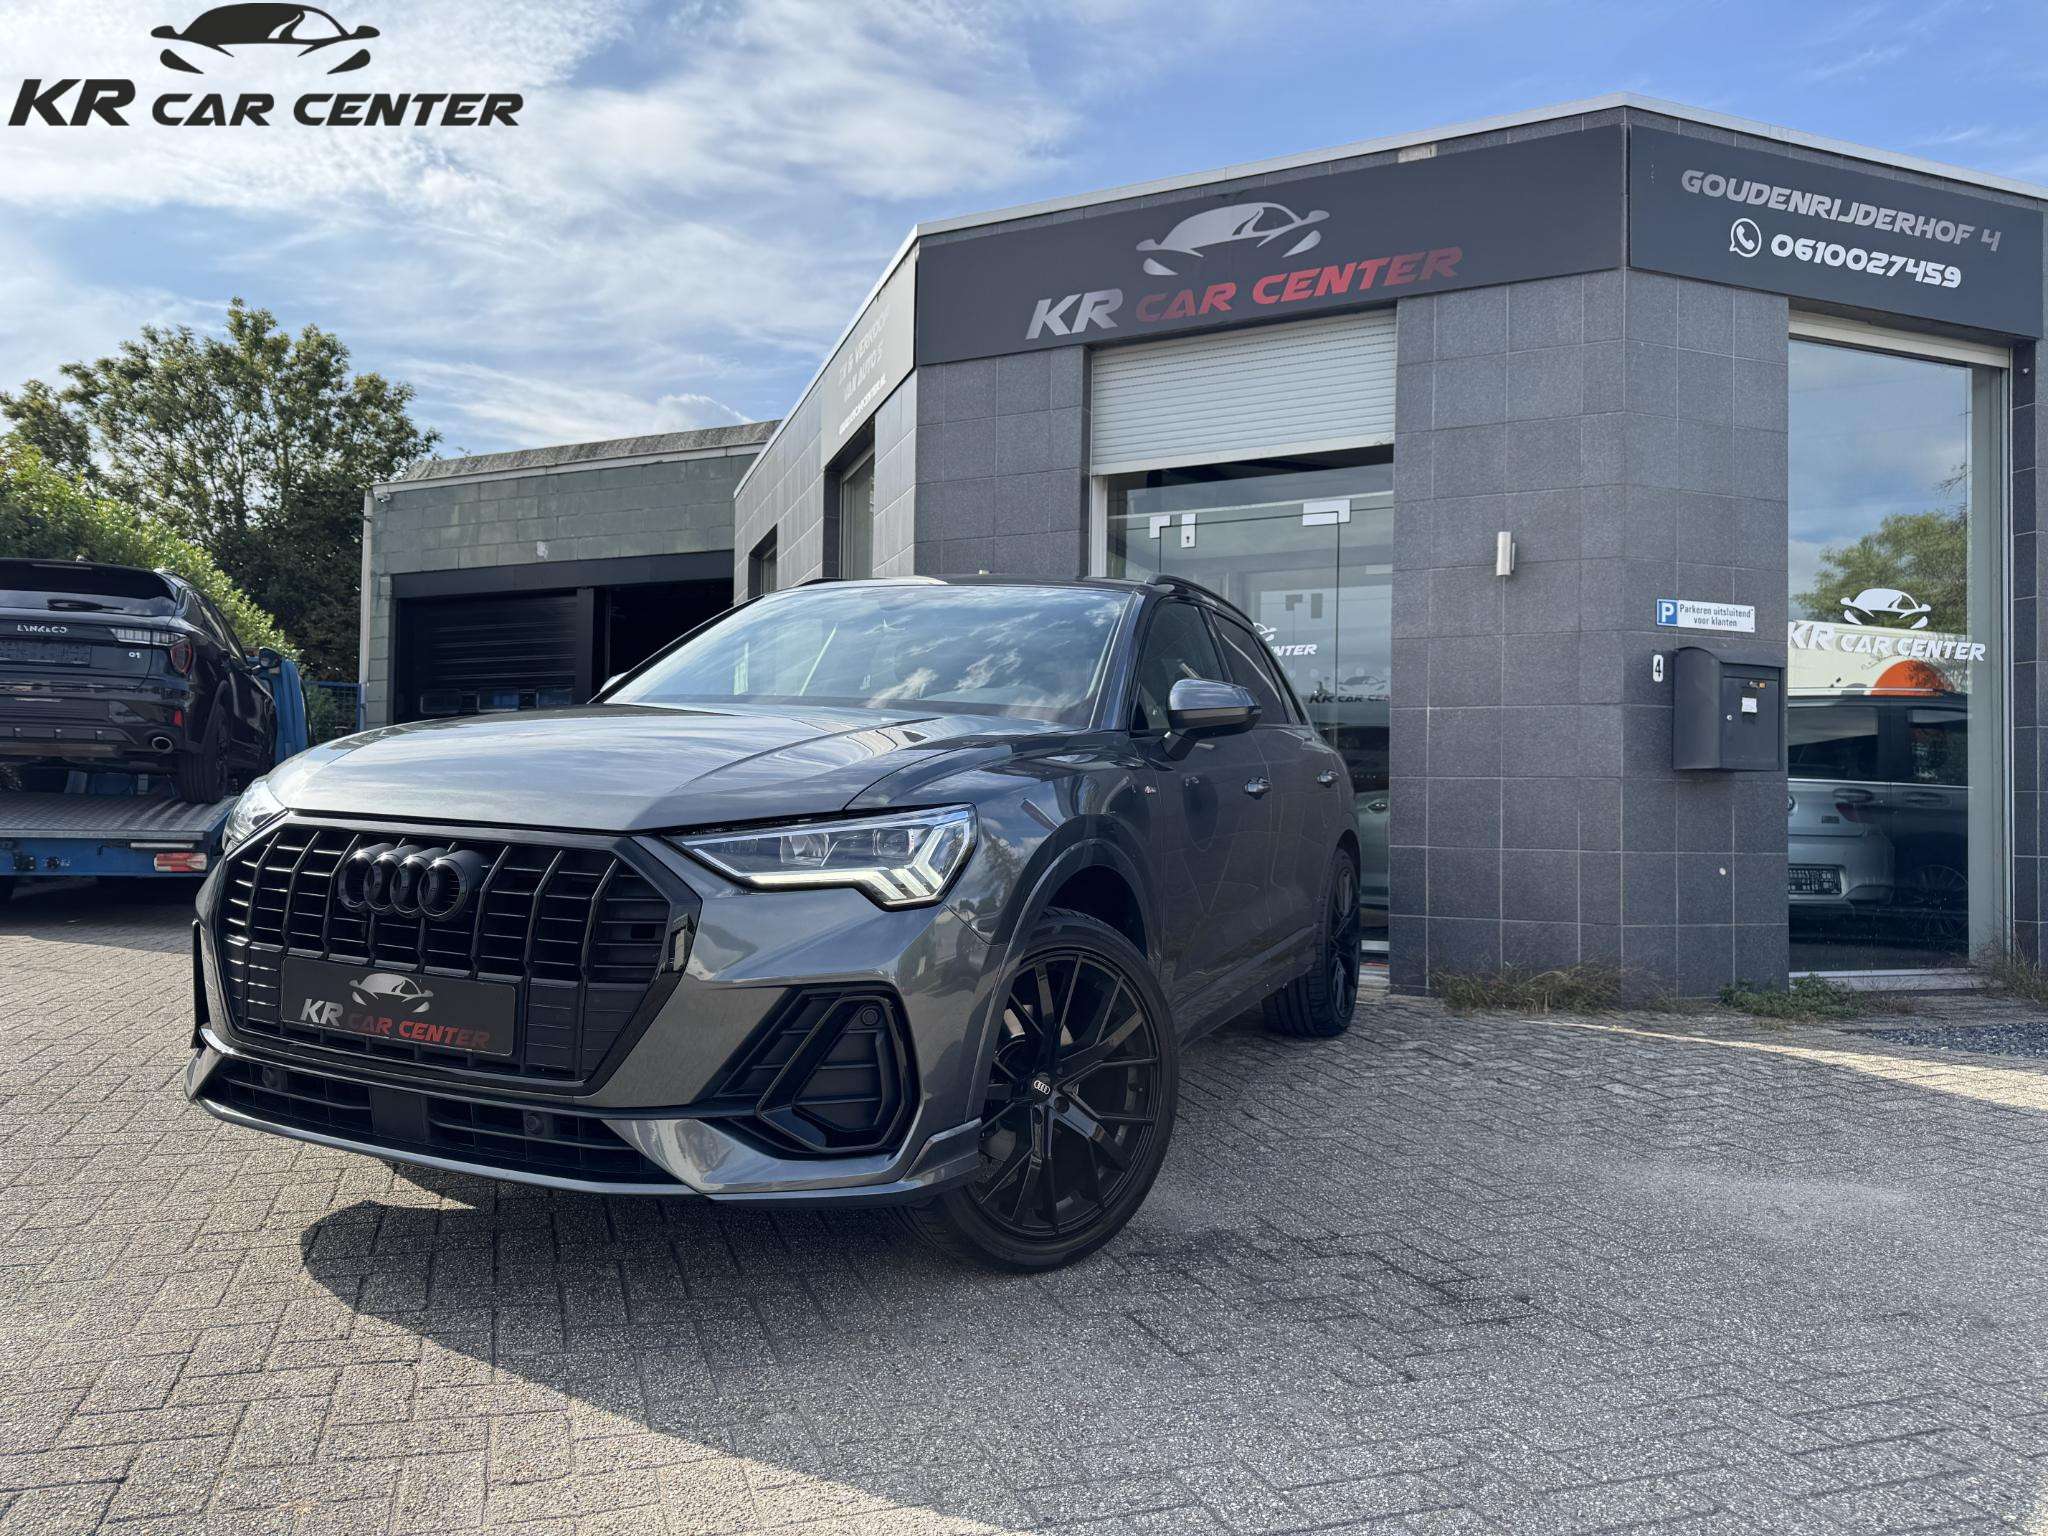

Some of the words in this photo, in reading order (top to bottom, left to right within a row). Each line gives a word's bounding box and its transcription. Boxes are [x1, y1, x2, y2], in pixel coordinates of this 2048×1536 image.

[1681, 169, 1976, 245] GOUDENRIJDERHOF
[1981, 231, 2002, 252] 4
[1771, 234, 1961, 289] 0610027459
[1025, 288, 1123, 339] KR
[1136, 282, 1237, 322] CAR
[1253, 247, 1463, 304] CENTER
[1661, 603, 1675, 622] P
[1680, 603, 1712, 615] Parkeren
[1713, 607, 1751, 618] uitsluitend
[1694, 617, 1709, 625] voor
[1711, 616, 1738, 627] klanten
[1271, 644, 1317, 656] NTER
[1788, 621, 1835, 649] KR
[1841, 634, 1892, 656] CAR
[1898, 638, 1986, 661] CENTER
[128, 651, 141, 659] 01
[1654, 658, 1662, 677] 4
[300, 998, 344, 1026] KR
[349, 1013, 393, 1035] CAR
[399, 1020, 490, 1048] CENTER
